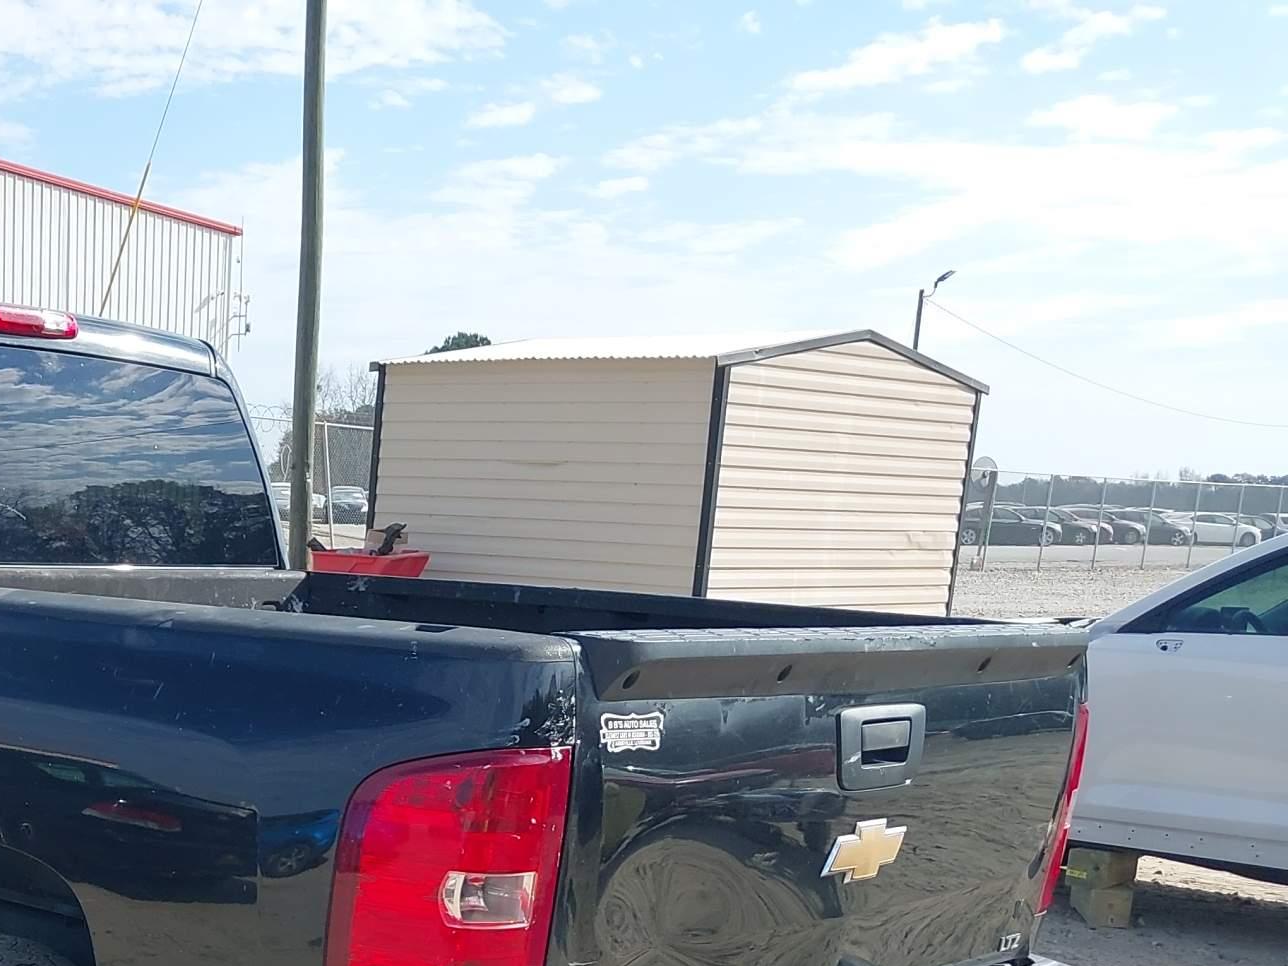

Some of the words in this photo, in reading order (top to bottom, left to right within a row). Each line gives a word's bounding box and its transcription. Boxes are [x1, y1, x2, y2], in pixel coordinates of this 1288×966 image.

[624, 720, 638, 729] AUTO
[639, 719, 658, 729] SALES
[998, 932, 1022, 951] LTZ
